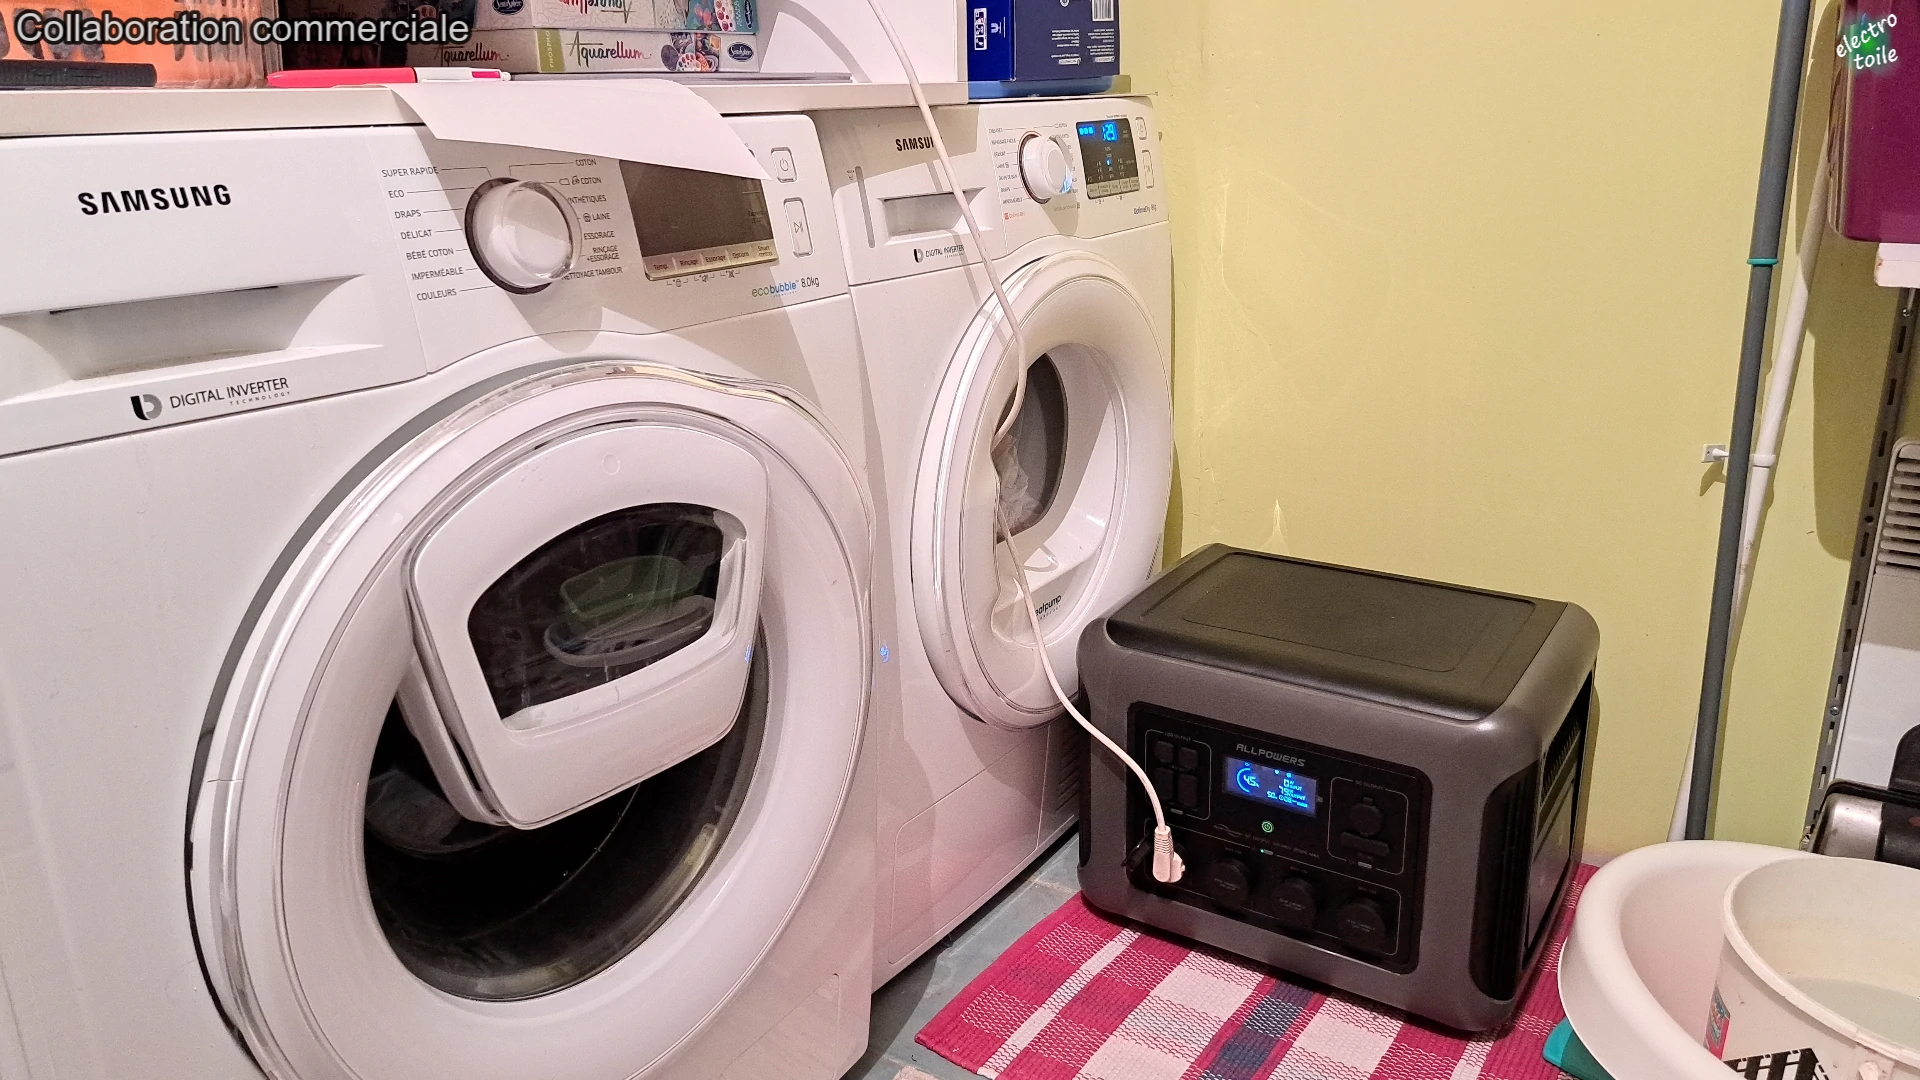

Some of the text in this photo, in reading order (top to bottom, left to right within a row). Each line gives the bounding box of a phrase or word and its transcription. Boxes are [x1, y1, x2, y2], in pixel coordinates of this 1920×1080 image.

[433, 42, 502, 67] Aquarellum
[566, 31, 650, 68] Aquarellum
[895, 136, 936, 152] SAMSU
[382, 166, 439, 178] SUPER RAPIDE
[581, 177, 602, 185] COTON
[77, 183, 232, 216] SAMSUNG
[388, 190, 404, 199] ECO
[394, 209, 421, 219] DRAPS
[593, 213, 611, 221] LAINE
[584, 231, 615, 240] ESSORAGE
[428, 248, 454, 258] COTON
[596, 267, 623, 276] TAMBOUR
[752, 280, 797, 298] ecobubble
[801, 276, 820, 288] 8.0kg
[417, 288, 457, 301] COULEURS
[169, 377, 289, 409] DIGITAL INVERTER
[229, 391, 291, 406] TECHNOLOGY
[1035, 594, 1062, 617] eatpump
[1236, 743, 1306, 767] ALLPOWERS
